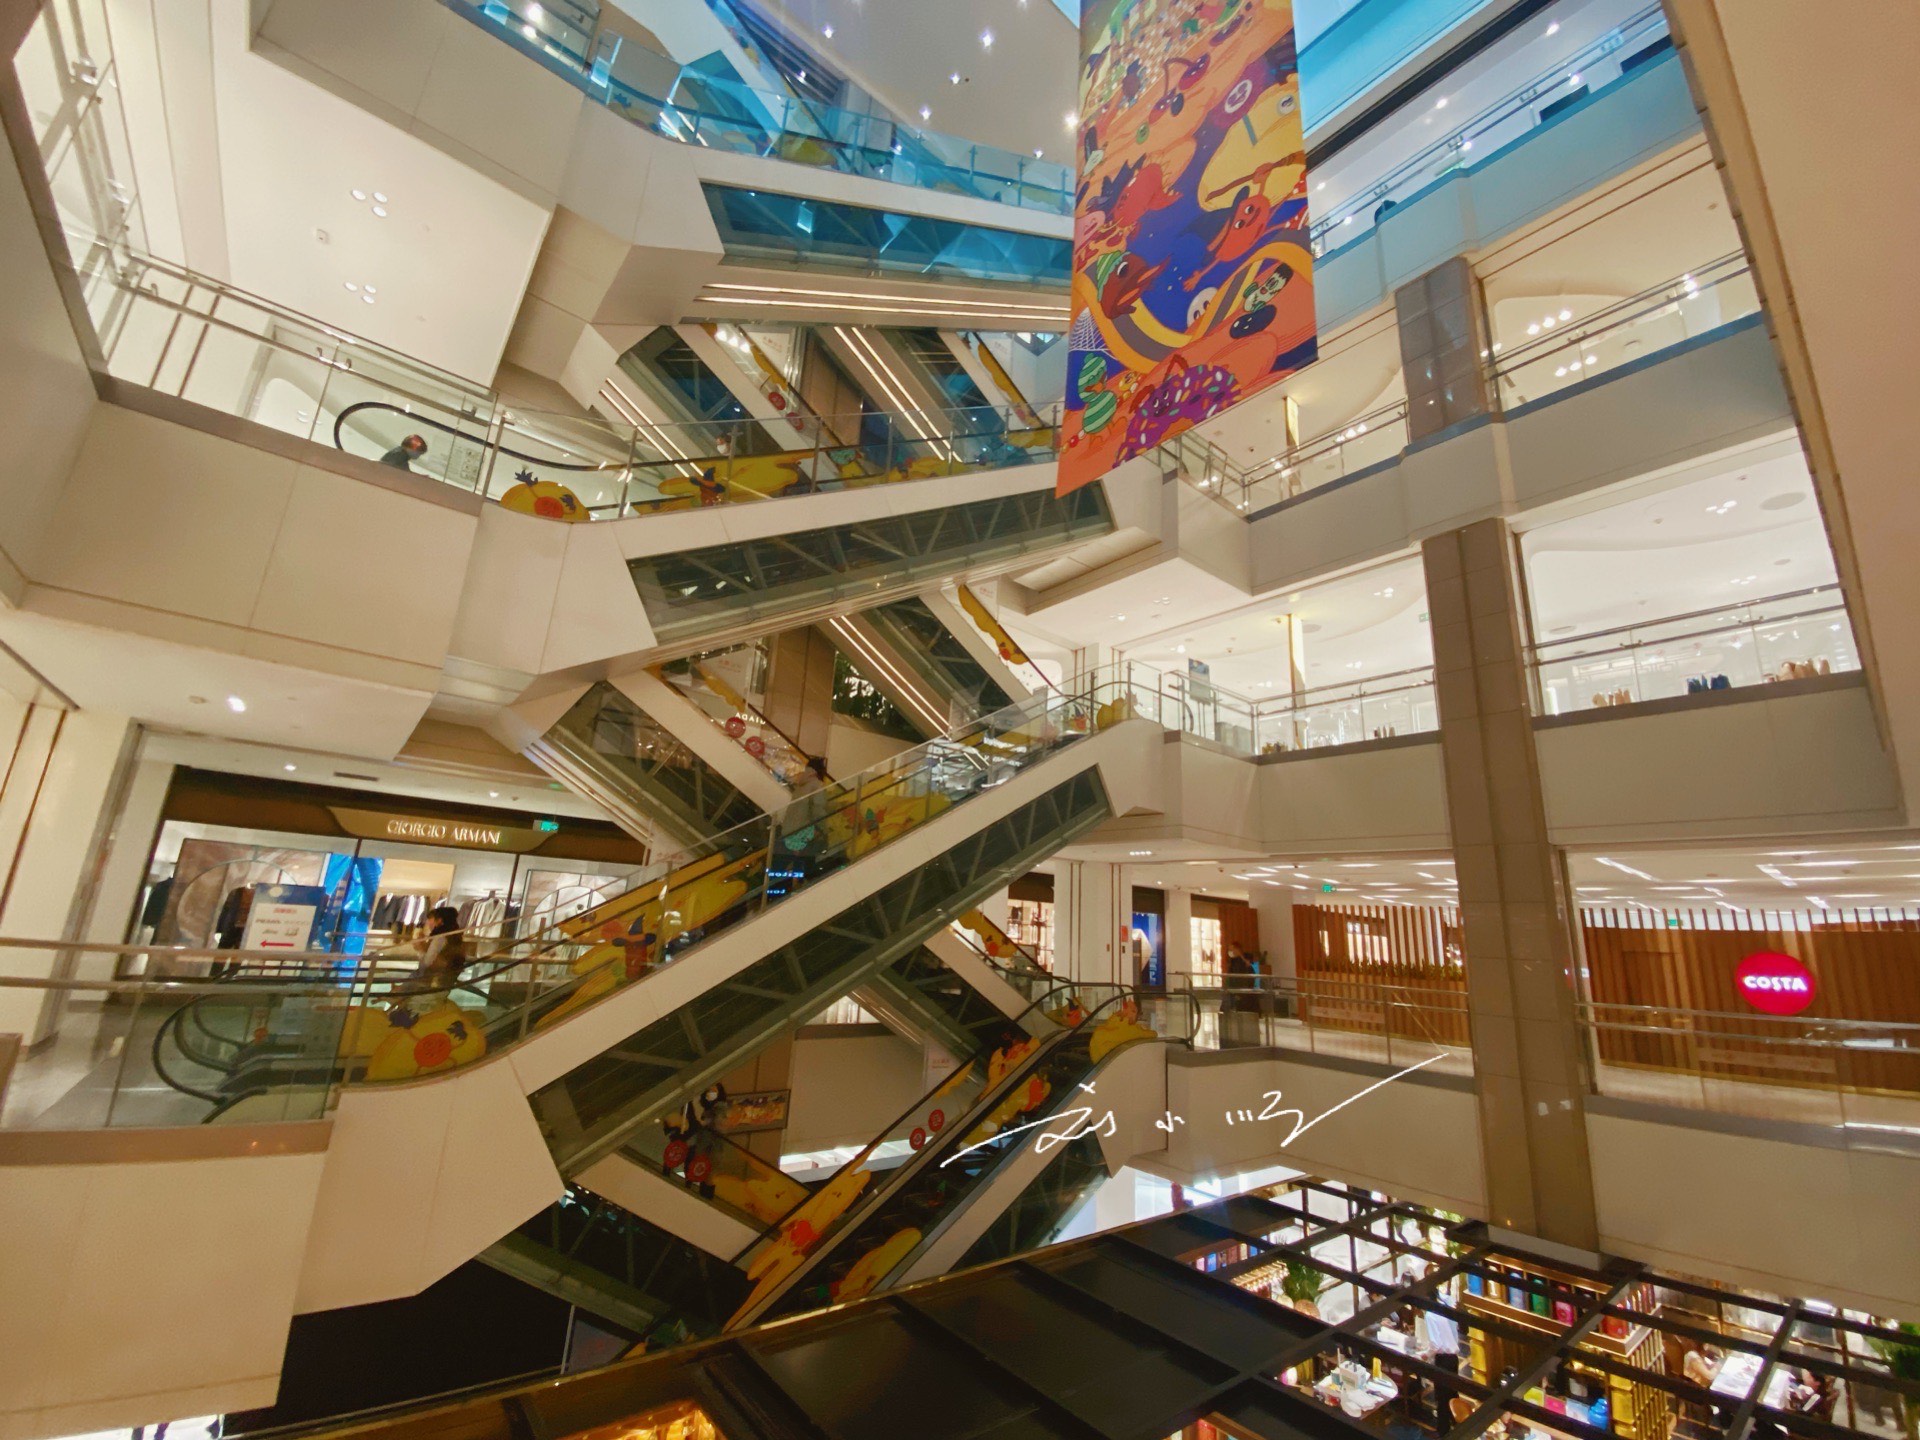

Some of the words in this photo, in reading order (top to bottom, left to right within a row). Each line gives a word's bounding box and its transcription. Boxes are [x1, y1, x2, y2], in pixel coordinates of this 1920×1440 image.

[387, 819, 446, 838] GIORGIO
[451, 827, 502, 845] ARMANI
[1743, 975, 1808, 992] COSTA
